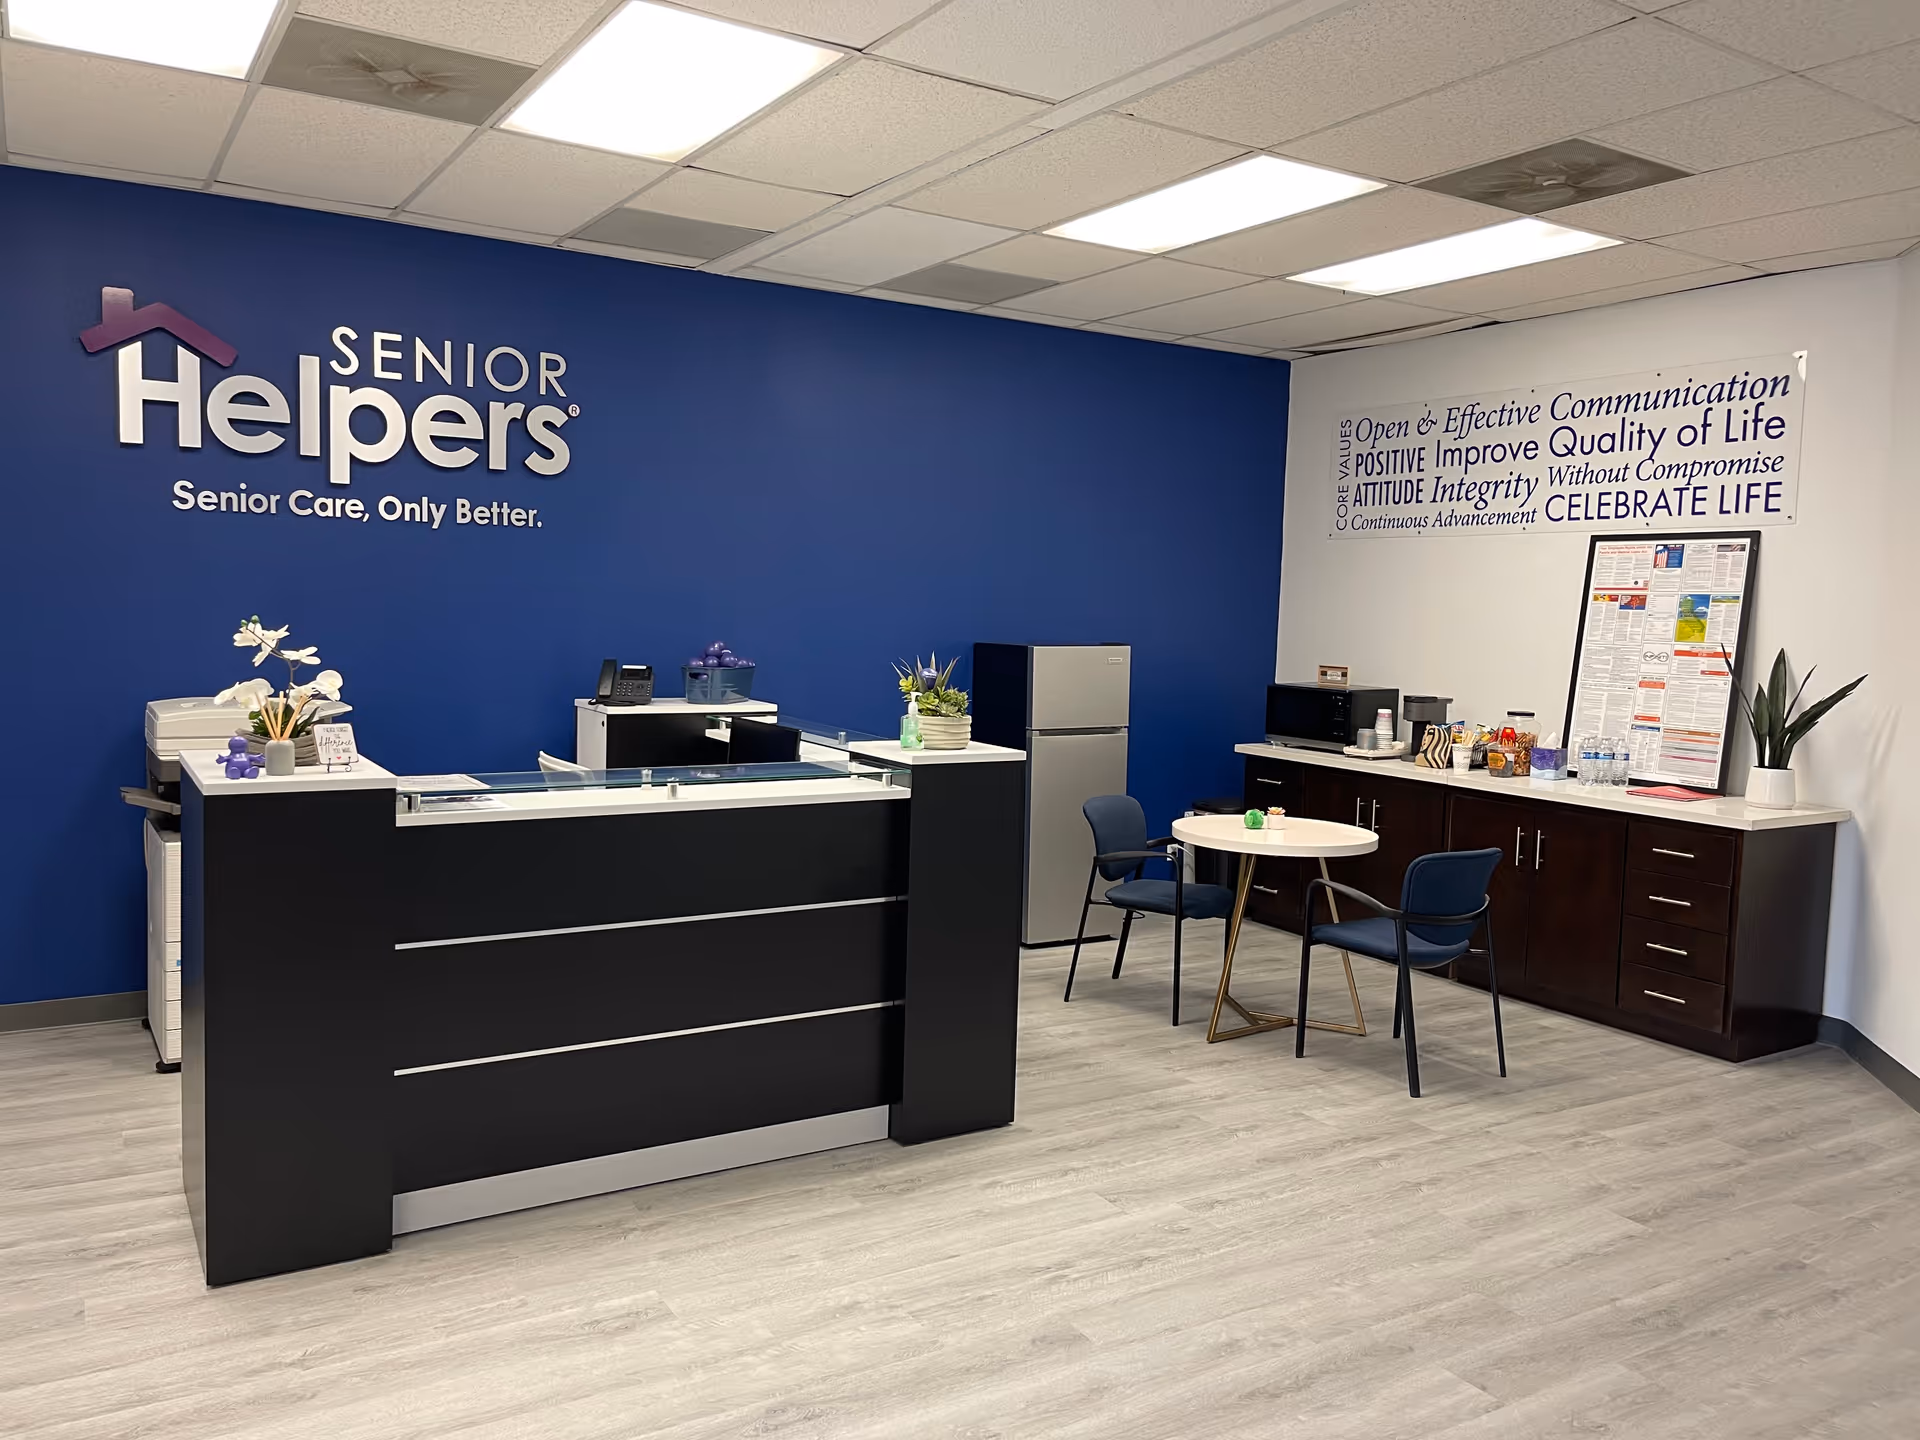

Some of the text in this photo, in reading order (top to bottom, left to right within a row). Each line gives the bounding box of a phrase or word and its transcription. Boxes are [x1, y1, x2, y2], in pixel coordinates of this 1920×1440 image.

[330, 325, 568, 397] SENIOR
[1355, 371, 1790, 449] Open & Effective Communication
[1355, 447, 1426, 477] POSITIVE
[1435, 402, 1786, 475] Improve Quality of Life
[1336, 419, 1352, 531] CORE VALUES
[1353, 478, 1424, 507] ATTITUDE
[1429, 451, 1784, 510] Integrity Without Compromise
[1545, 481, 1783, 522] CELEBRATE LIFE
[172, 480, 543, 529] Senior Care, Only Better.
[1351, 507, 1538, 531] Continuous Advancement
